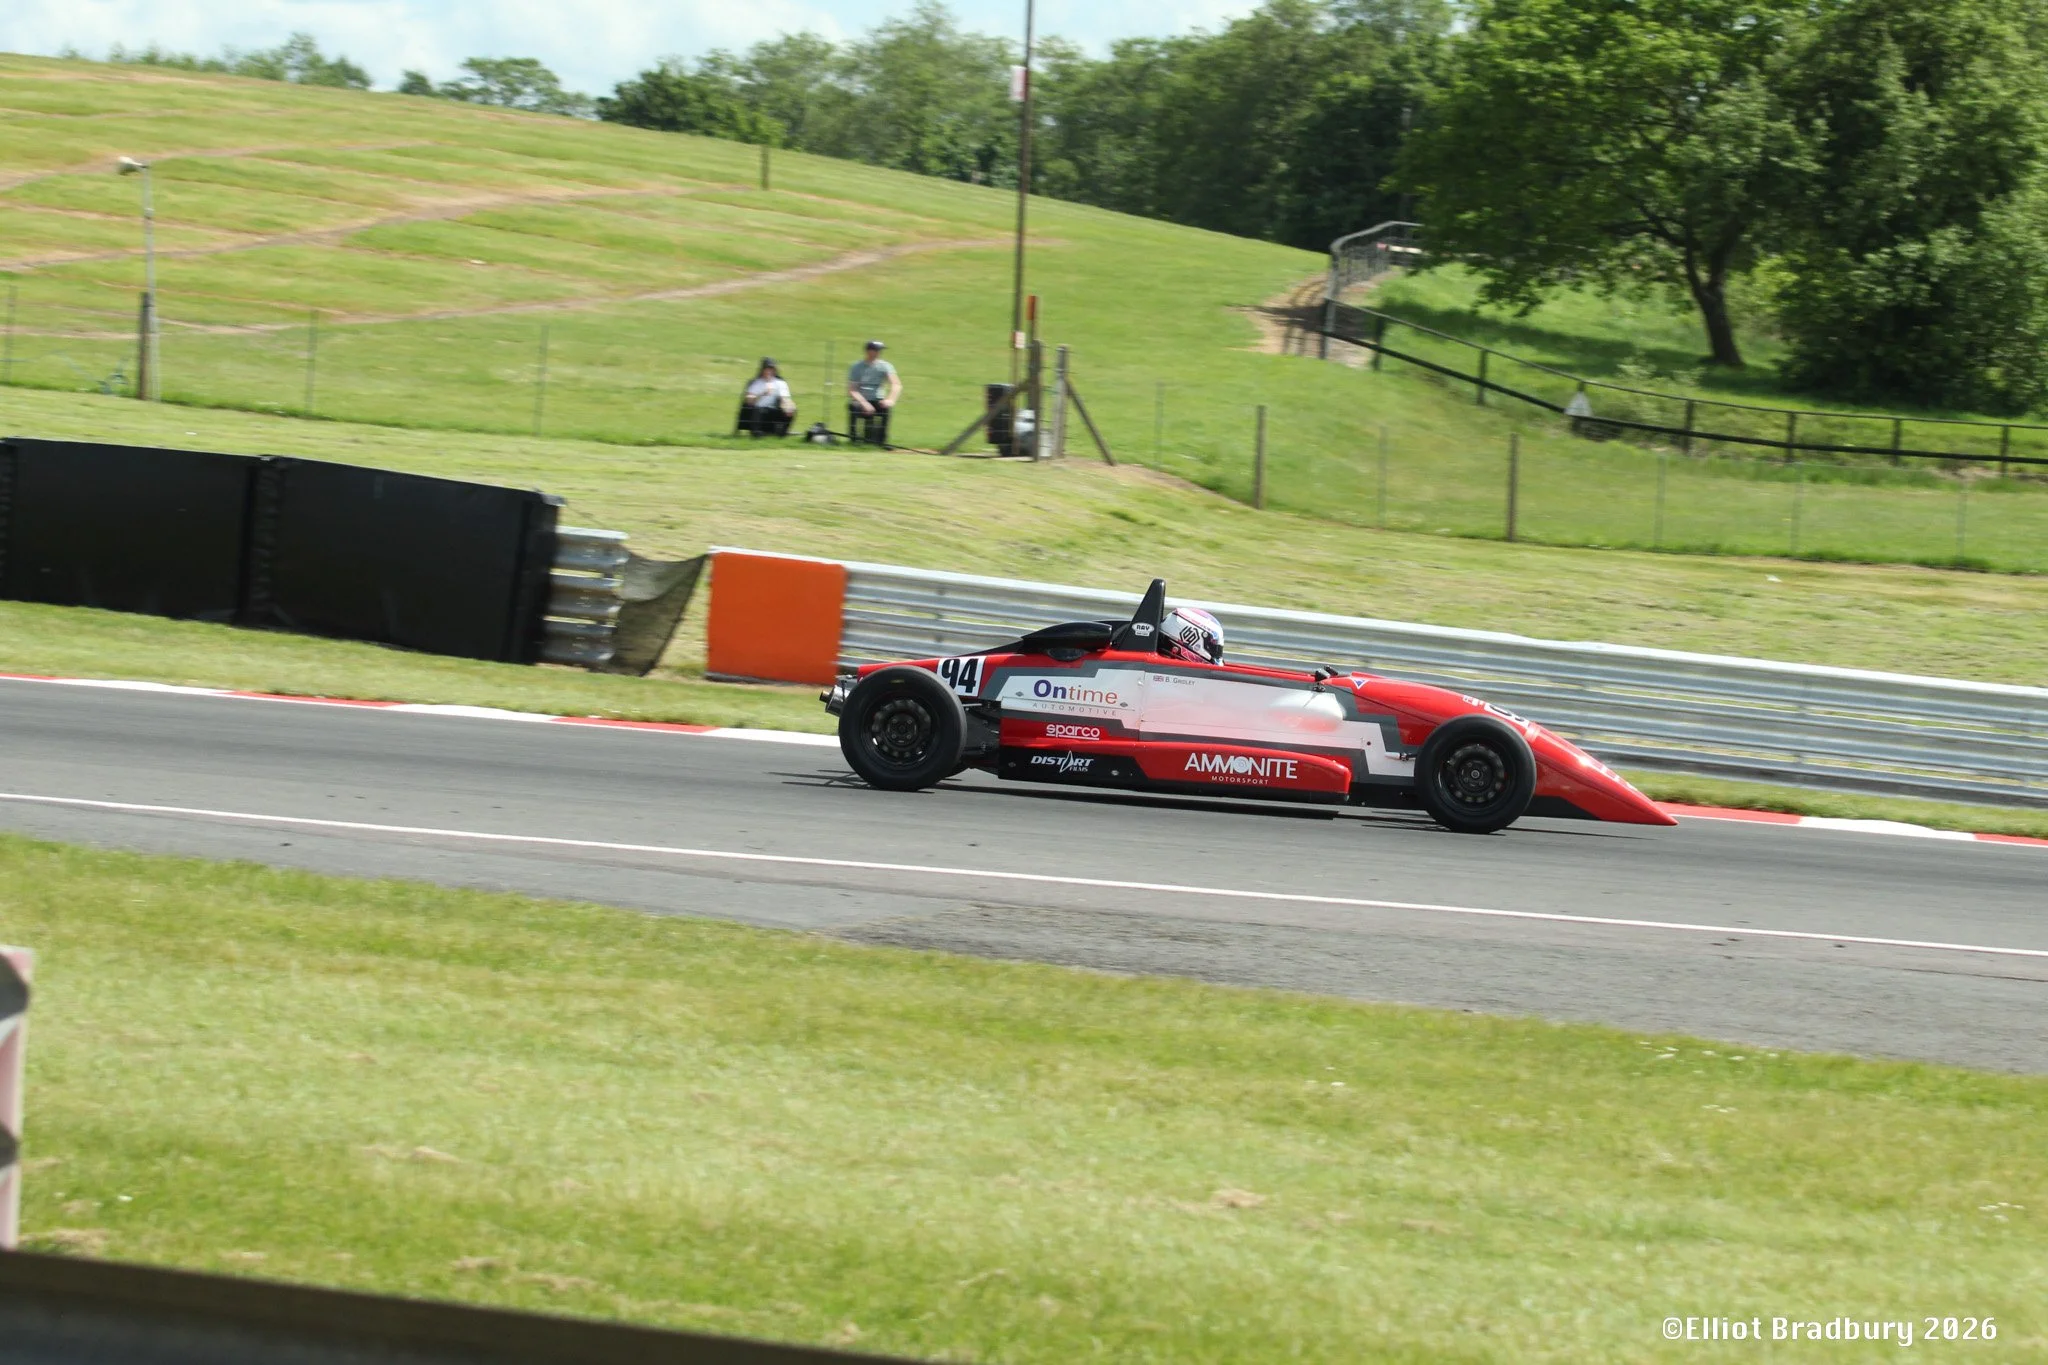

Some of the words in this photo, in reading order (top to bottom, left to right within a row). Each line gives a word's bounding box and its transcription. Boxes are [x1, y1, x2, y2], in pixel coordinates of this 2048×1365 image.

[941, 658, 979, 694] 94
[1034, 679, 1118, 705] Ontime
[1032, 702, 1117, 717] AUTOMOTIVE
[1046, 723, 1100, 741] sparco
[1184, 752, 1298, 779] AMMONITE
[1211, 775, 1269, 786] MOTORSPORT
